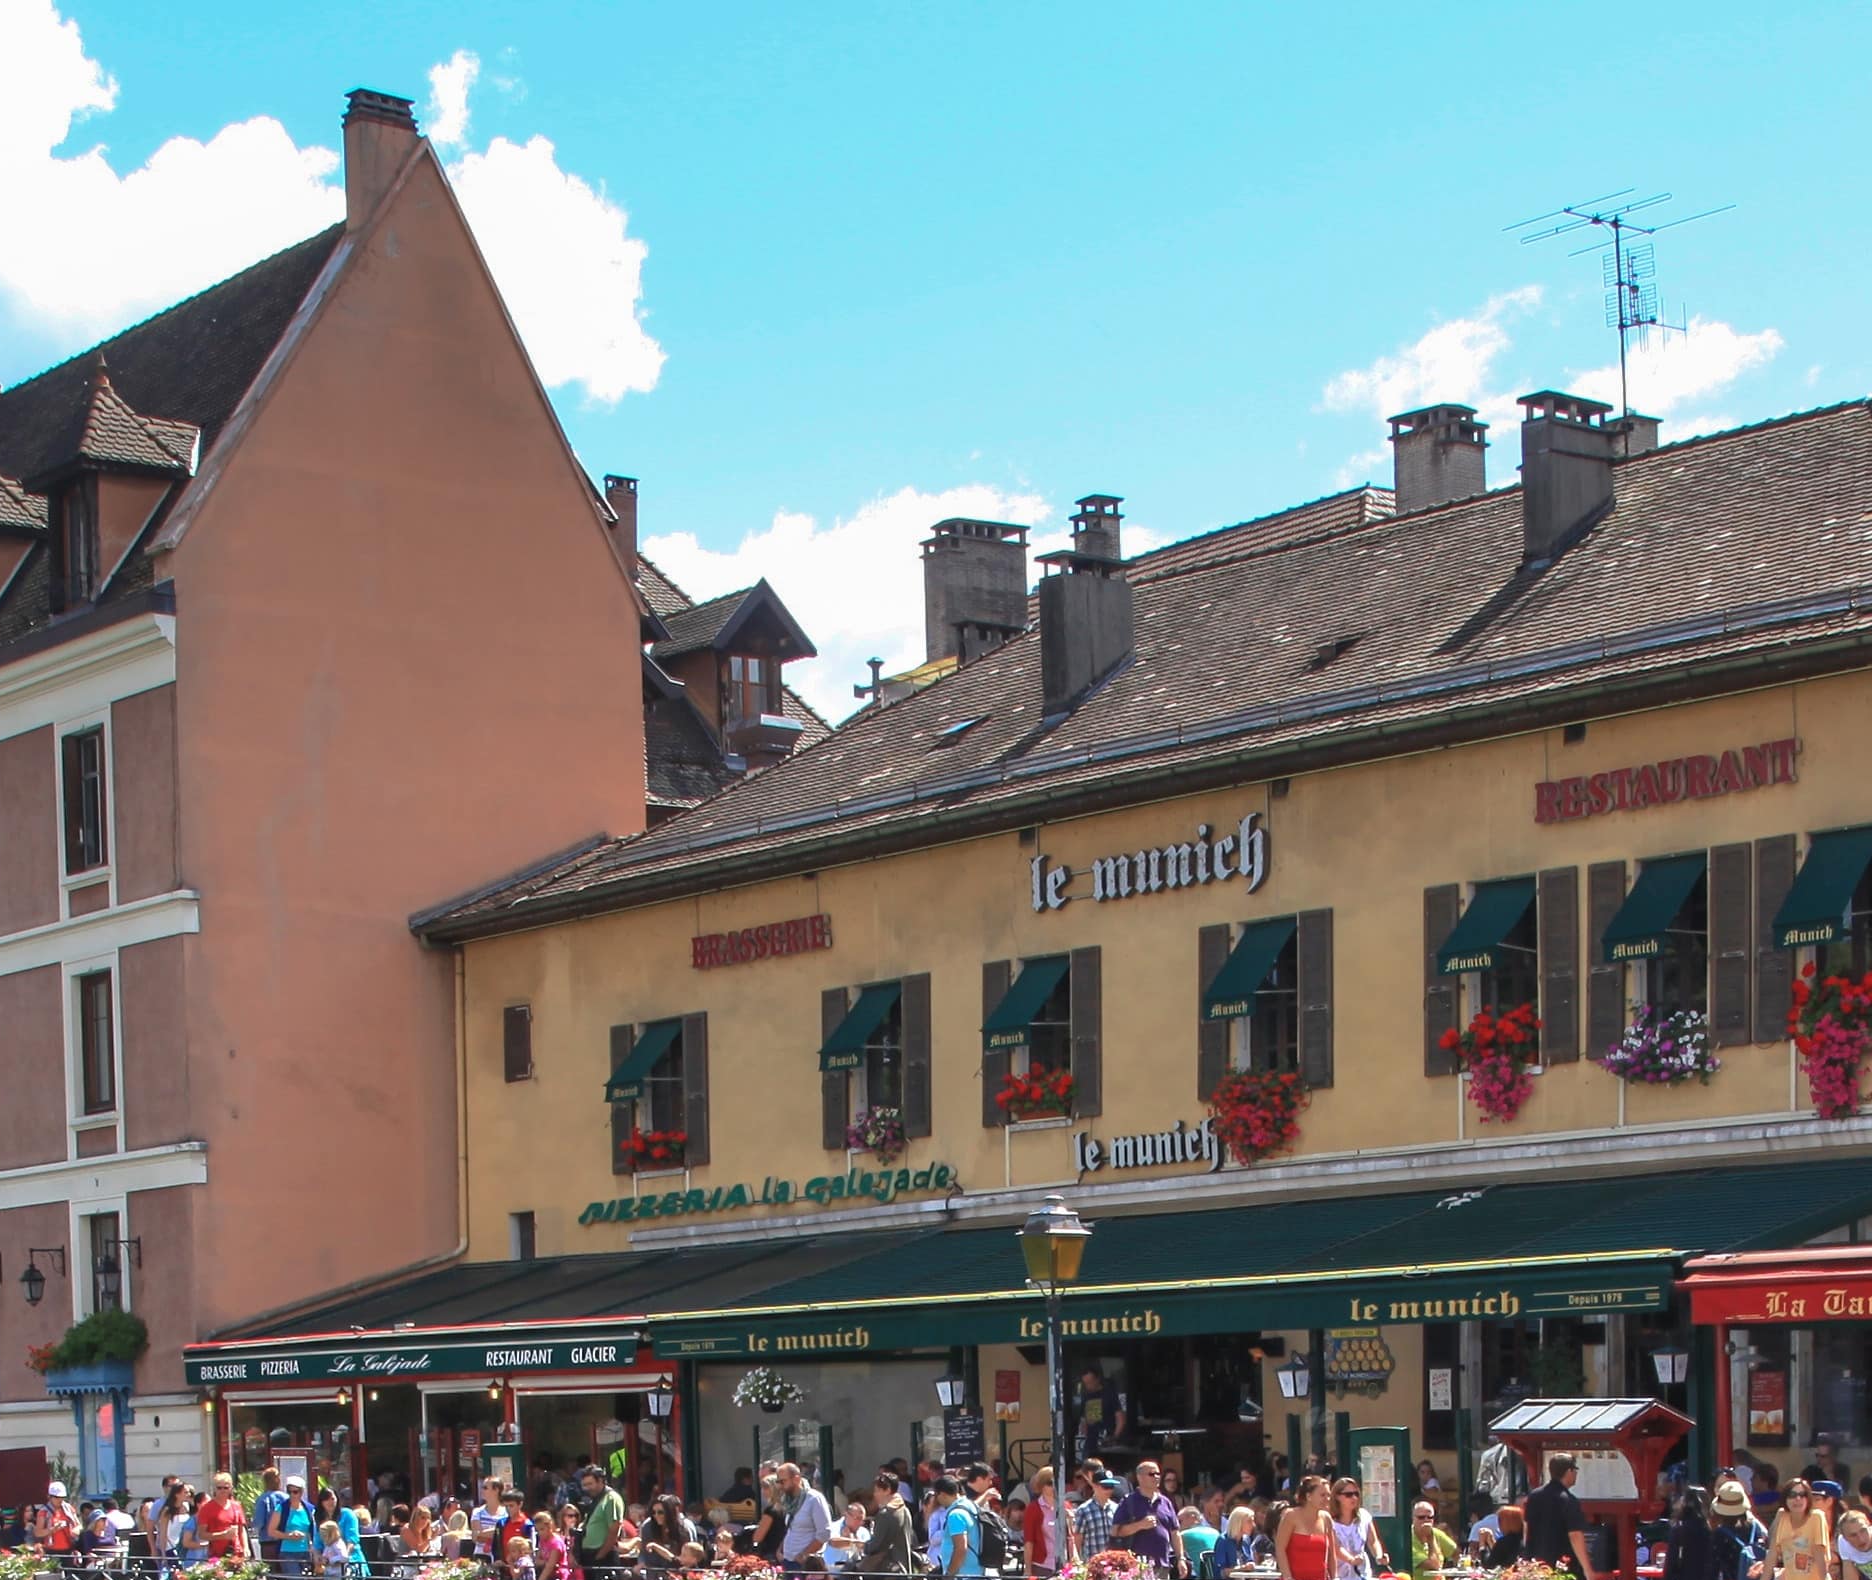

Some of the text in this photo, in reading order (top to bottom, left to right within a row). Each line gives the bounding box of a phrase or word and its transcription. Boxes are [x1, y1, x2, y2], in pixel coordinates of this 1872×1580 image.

[1534, 738, 1803, 824] RESTAURANT
[1029, 812, 1268, 912] le munich
[692, 913, 832, 970] BRASSERIE
[1784, 926, 1832, 946] Munich
[1612, 939, 1658, 960] Munich
[1445, 953, 1491, 972] Munich
[1210, 1001, 1248, 1018] Munich
[990, 1032, 1025, 1047] Munich
[1073, 1118, 1222, 1172] le munich
[578, 1183, 753, 1225] PIZZERIA
[1350, 1290, 1520, 1321] le munich
[1568, 1295, 1599, 1305] Depuis
[1766, 1291, 1806, 1318] La
[747, 1327, 870, 1351] le munich
[1020, 1317, 1044, 1337] le
[201, 1364, 247, 1380] BRASSERIE
[261, 1360, 300, 1375] PIZZERIA
[328, 1355, 357, 1374] La
[486, 1346, 616, 1367] RESTAURANT GLACIER
